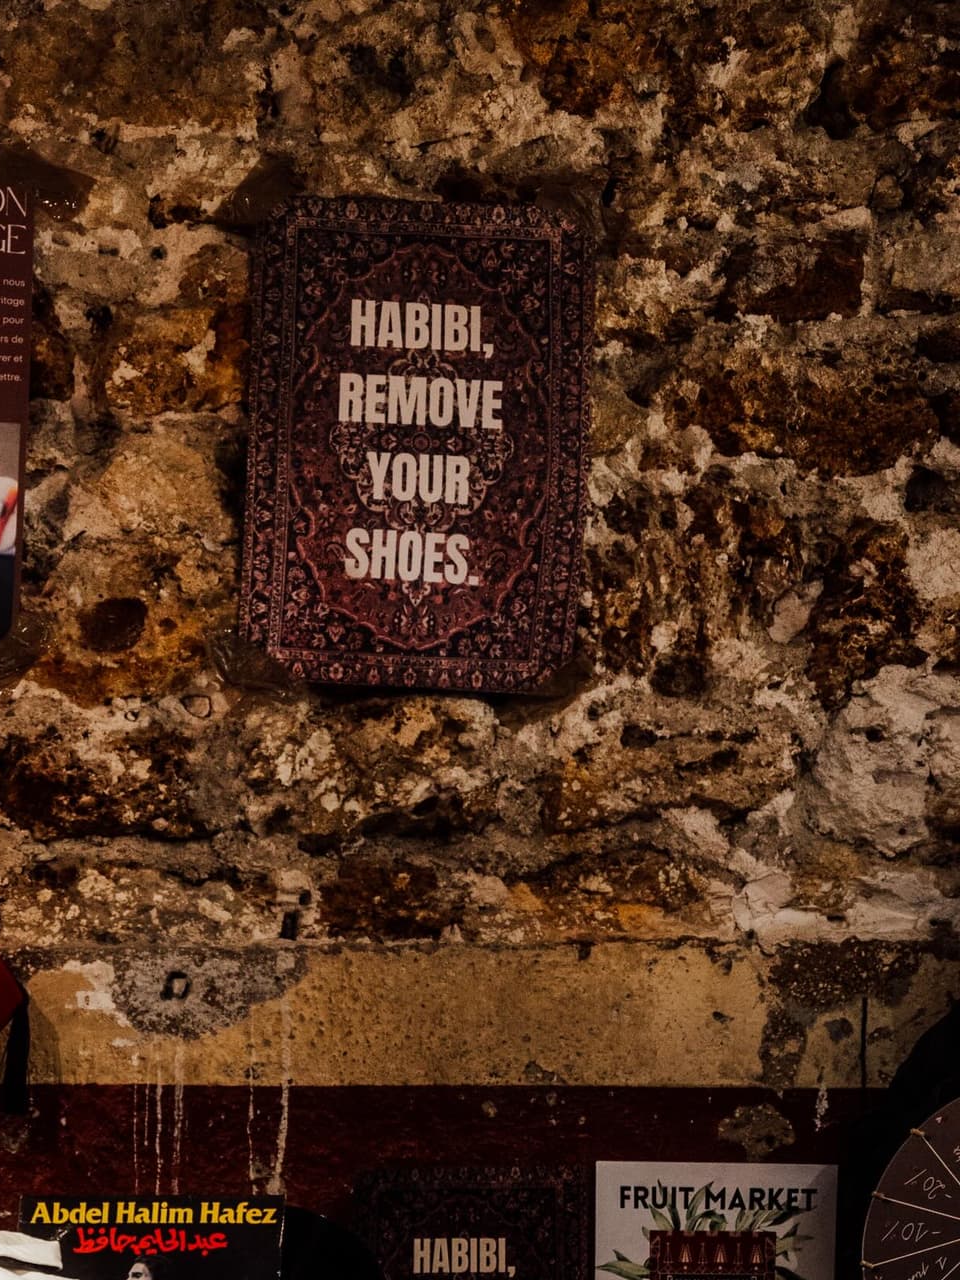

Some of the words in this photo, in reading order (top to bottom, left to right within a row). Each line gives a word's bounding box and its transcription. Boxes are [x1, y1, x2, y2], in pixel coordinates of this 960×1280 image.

[3, 278, 25, 287] nous
[3, 316, 24, 325] pour
[350, 299, 494, 359] HABIBI,
[11, 334, 24, 344] de
[13, 354, 23, 363] et
[338, 373, 503, 430] REMOVE
[366, 451, 470, 505] YOUR
[344, 527, 480, 586] SHOES.
[619, 1185, 694, 1210] FRUIT
[705, 1188, 817, 1212] MARKET
[30, 1201, 110, 1224] Abdel
[116, 1201, 193, 1224] Halim
[200, 1201, 278, 1225] Hafez
[73, 1227, 137, 1254] حافظ
[131, 1228, 187, 1256] الحليم
[187, 1232, 228, 1256] عبد
[412, 1237, 516, 1278] HABIBI,
